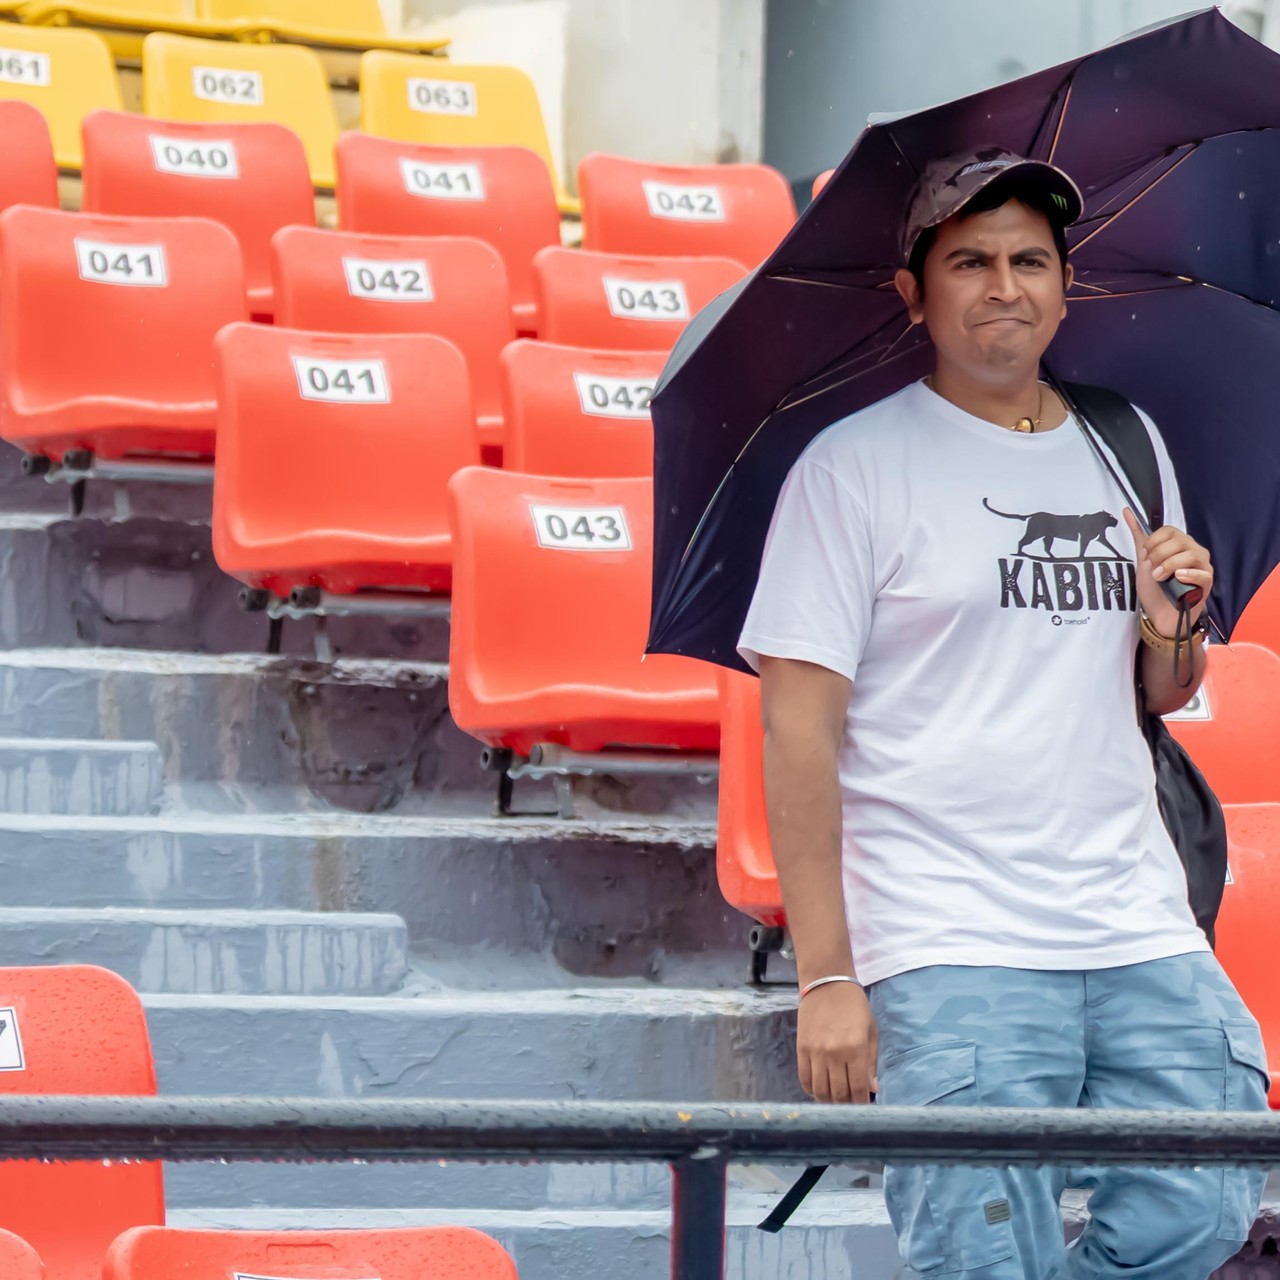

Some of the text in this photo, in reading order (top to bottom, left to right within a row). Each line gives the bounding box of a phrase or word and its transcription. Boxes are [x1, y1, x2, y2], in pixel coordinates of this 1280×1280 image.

[201, 74, 255, 98] 062
[416, 85, 469, 108] 063
[164, 146, 228, 169] 040
[413, 170, 471, 192] 041
[657, 192, 716, 213] 042
[89, 251, 153, 277] 041
[357, 268, 423, 292] 042
[618, 288, 681, 312] 043
[308, 367, 375, 393] 041
[588, 383, 650, 410] 042
[546, 515, 621, 542] 043
[998, 558, 1136, 612] KABINI
